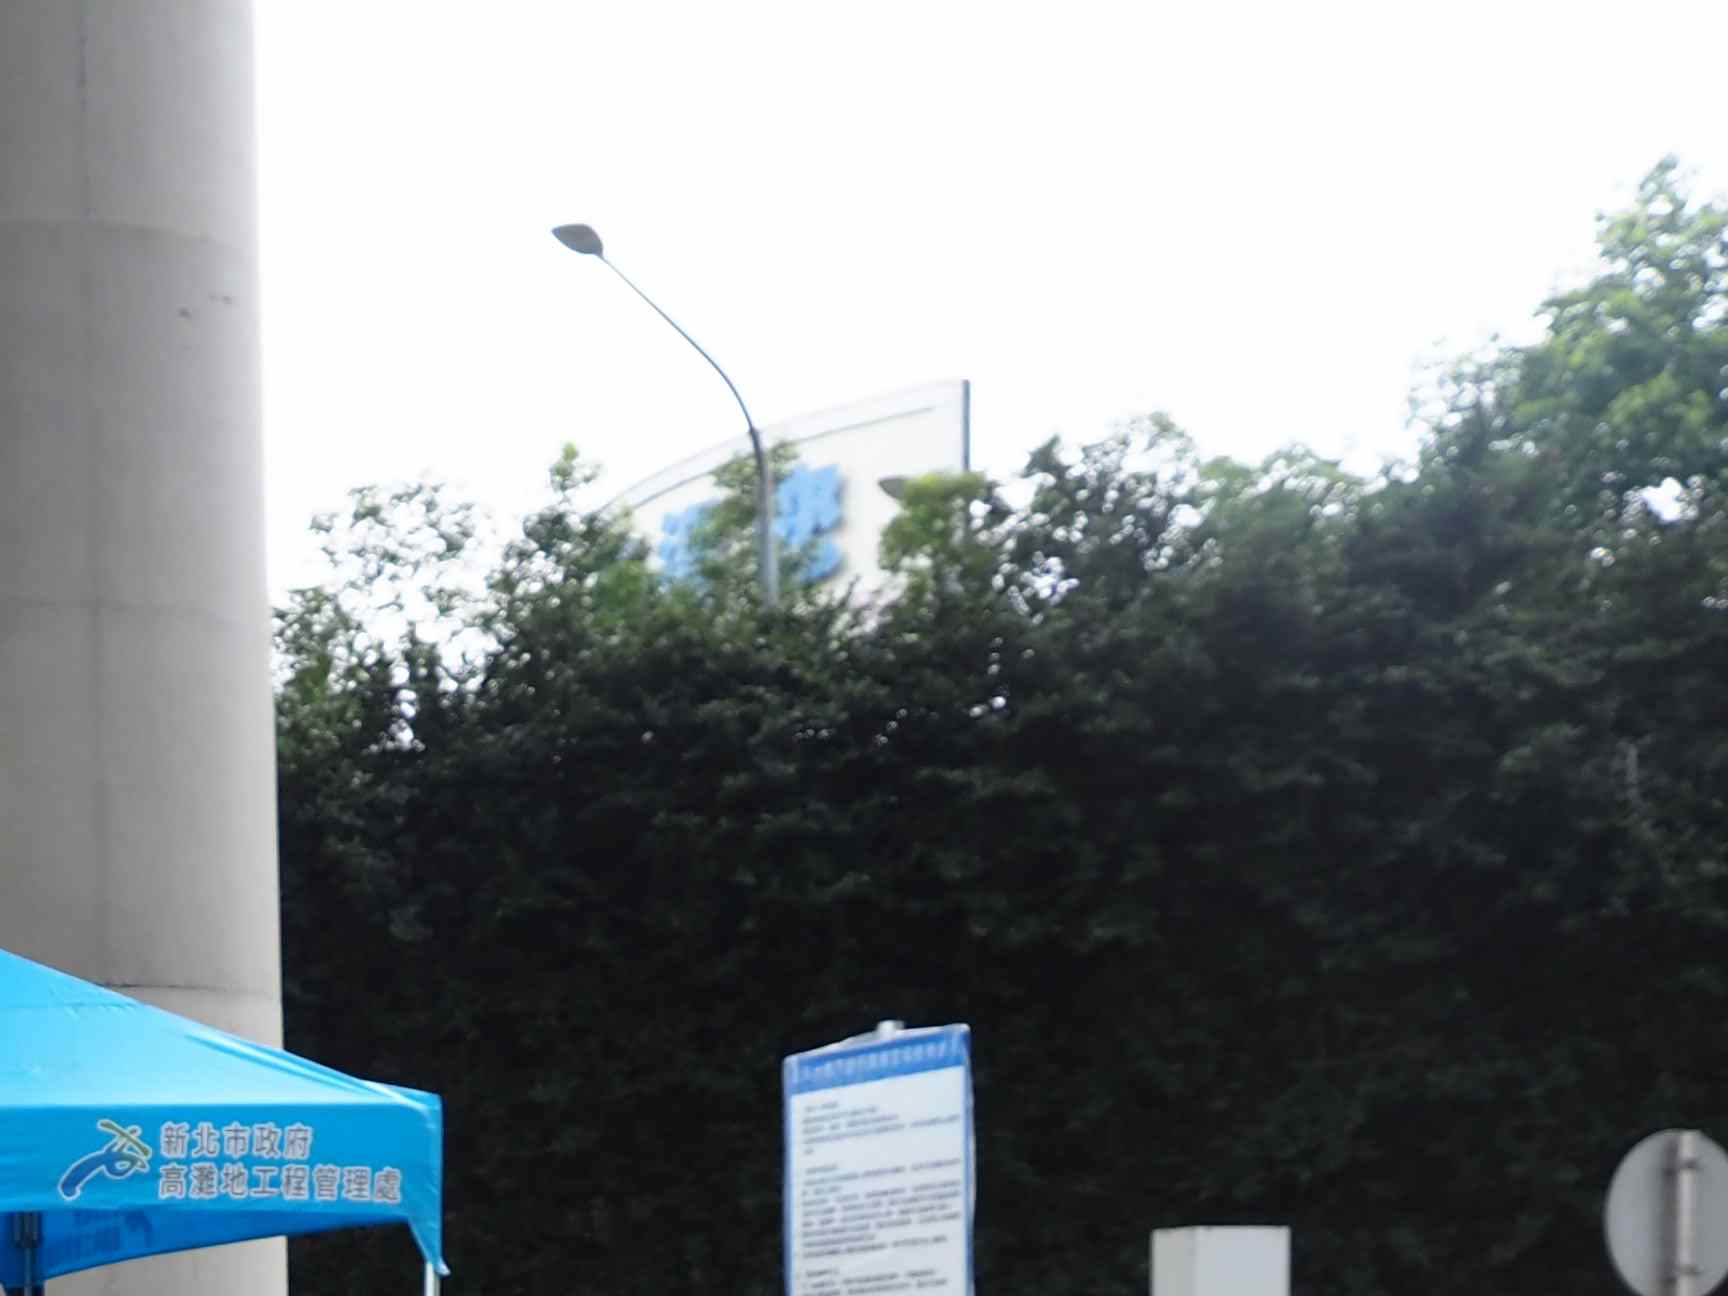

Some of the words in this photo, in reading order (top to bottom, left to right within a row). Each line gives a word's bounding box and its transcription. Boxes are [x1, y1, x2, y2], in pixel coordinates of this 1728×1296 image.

[159, 1122, 313, 1160] 新北市政府
[158, 1163, 403, 1203] 高灘地工程管理處
